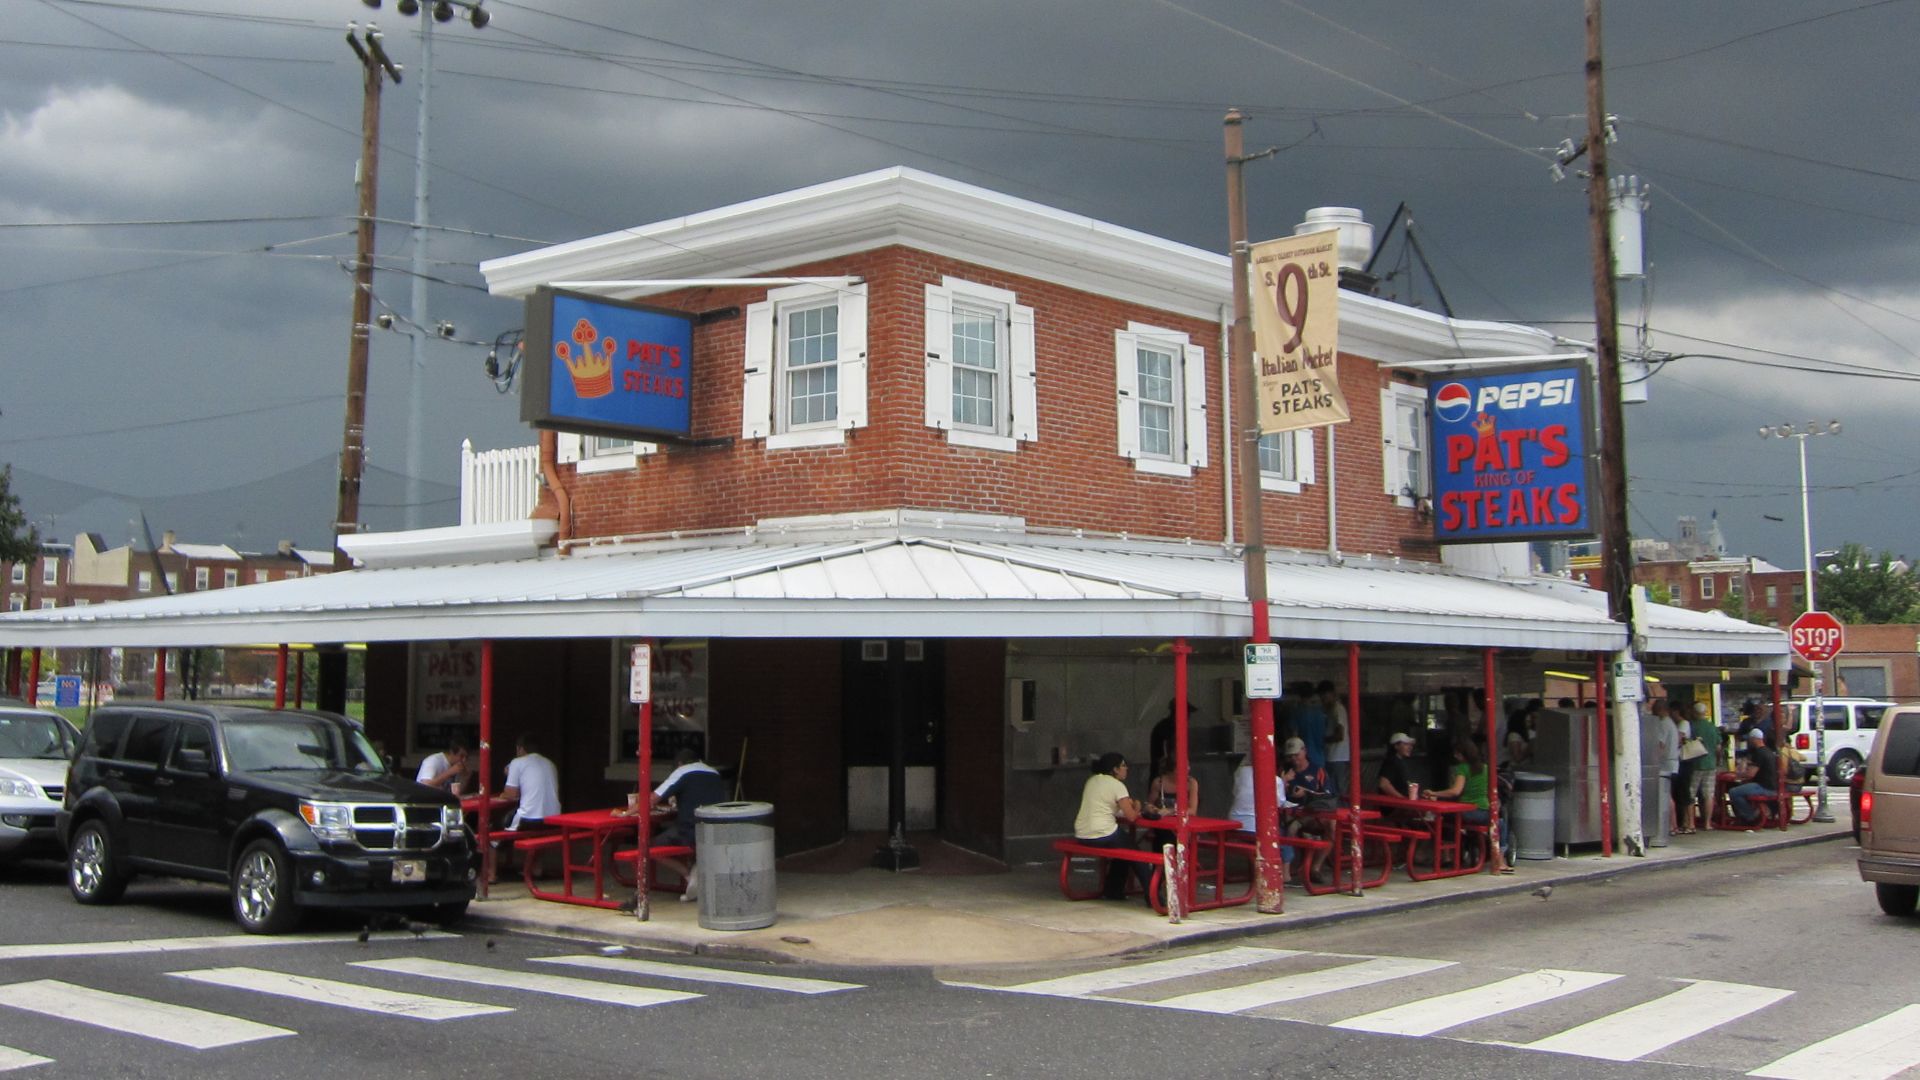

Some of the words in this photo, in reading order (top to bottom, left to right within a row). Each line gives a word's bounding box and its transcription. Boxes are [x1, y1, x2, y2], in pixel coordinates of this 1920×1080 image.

[1276, 262, 1309, 354] 9
[627, 339, 682, 369] PAT'S
[1262, 355, 1298, 376] Italian
[624, 369, 685, 399] STEAKS
[1281, 379, 1322, 397] PAT'S
[1476, 378, 1575, 412] PEPSI
[1272, 393, 1333, 416] STEAKS
[1447, 424, 1570, 474] PAT'S
[1474, 472, 1511, 487] KING
[1515, 469, 1536, 484] OF
[1441, 483, 1581, 531] STEAKS
[1794, 627, 1839, 646] STOP
